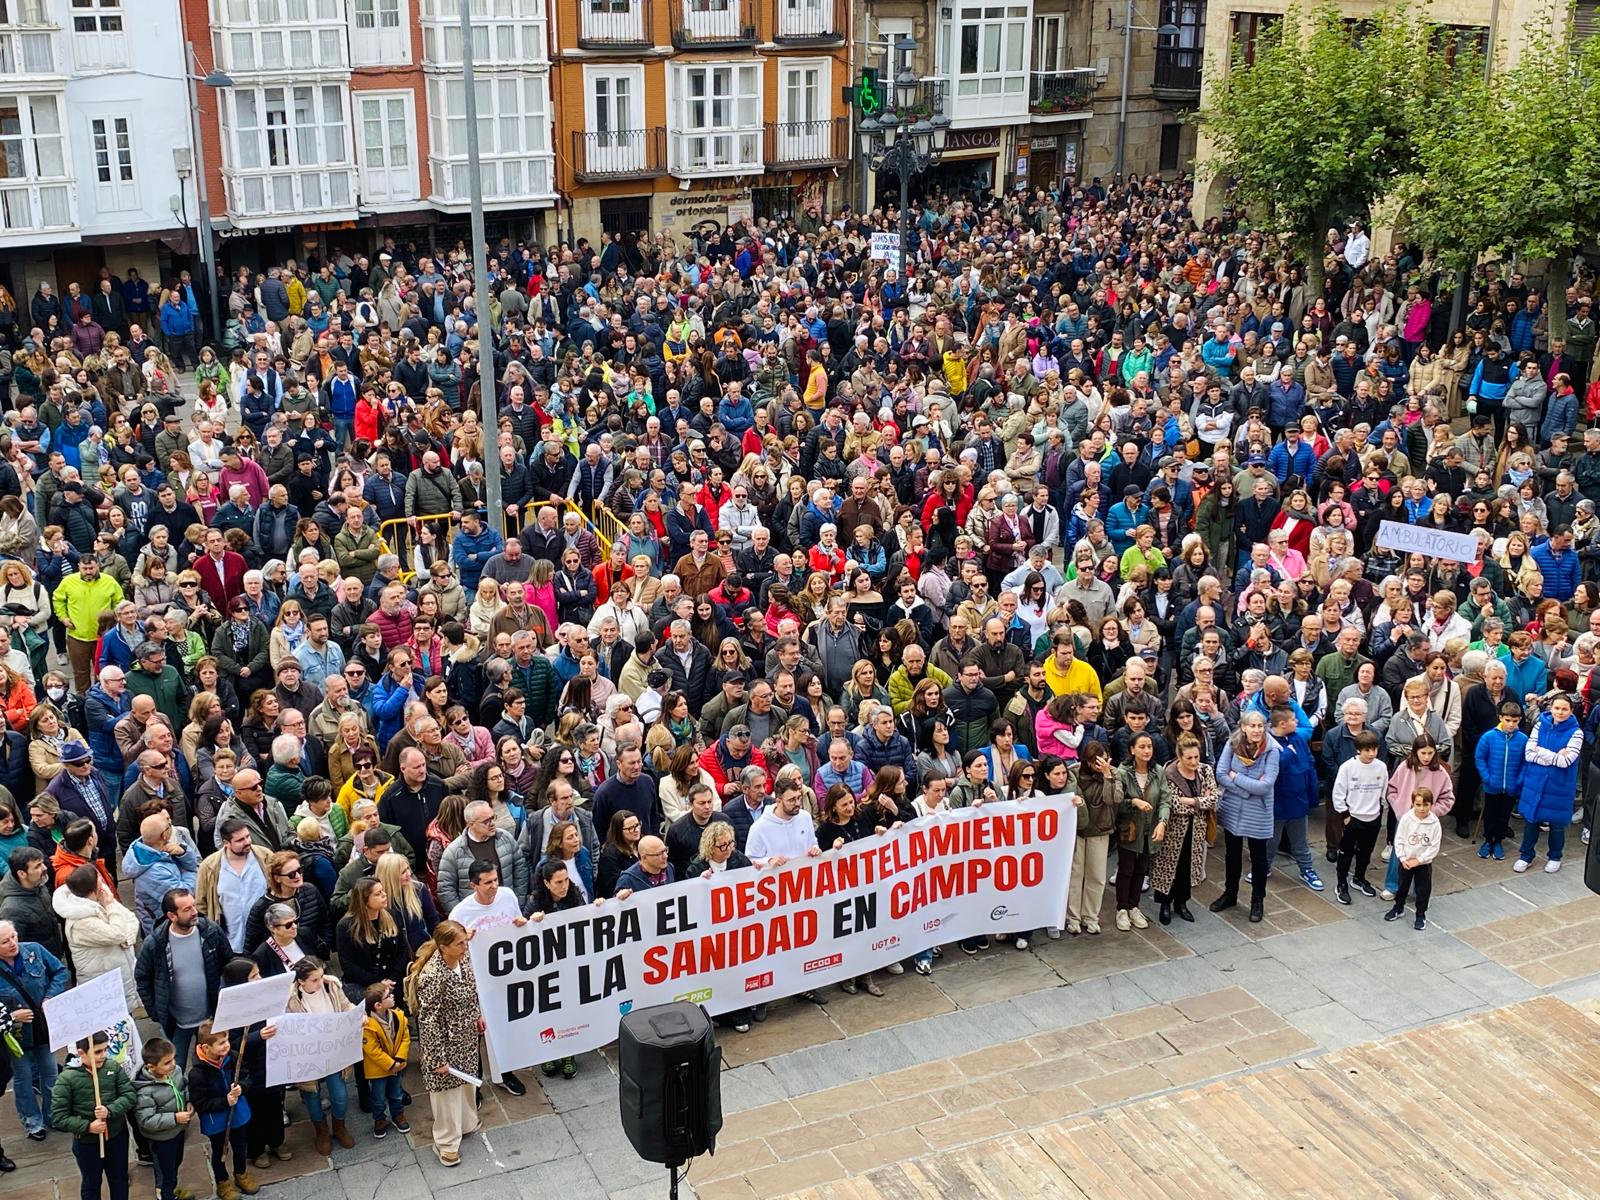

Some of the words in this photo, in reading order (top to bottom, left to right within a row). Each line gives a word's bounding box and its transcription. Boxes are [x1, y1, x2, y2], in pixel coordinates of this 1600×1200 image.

[1380, 525, 1472, 556] AMBULATORIO
[488, 907, 642, 977] CONTRA
[656, 895, 698, 936] EL
[711, 809, 1059, 925] DESMANTELAMIENTO
[923, 918, 941, 930] USO
[507, 970, 562, 1023] DE
[578, 954, 627, 1006] LA
[643, 909, 818, 985] SANIDAD
[833, 892, 877, 939] EN
[890, 851, 1044, 920] CAMPOO
[871, 938, 889, 951] UGT
[806, 957, 831, 971] CCOO
[690, 989, 710, 1002] PRC
